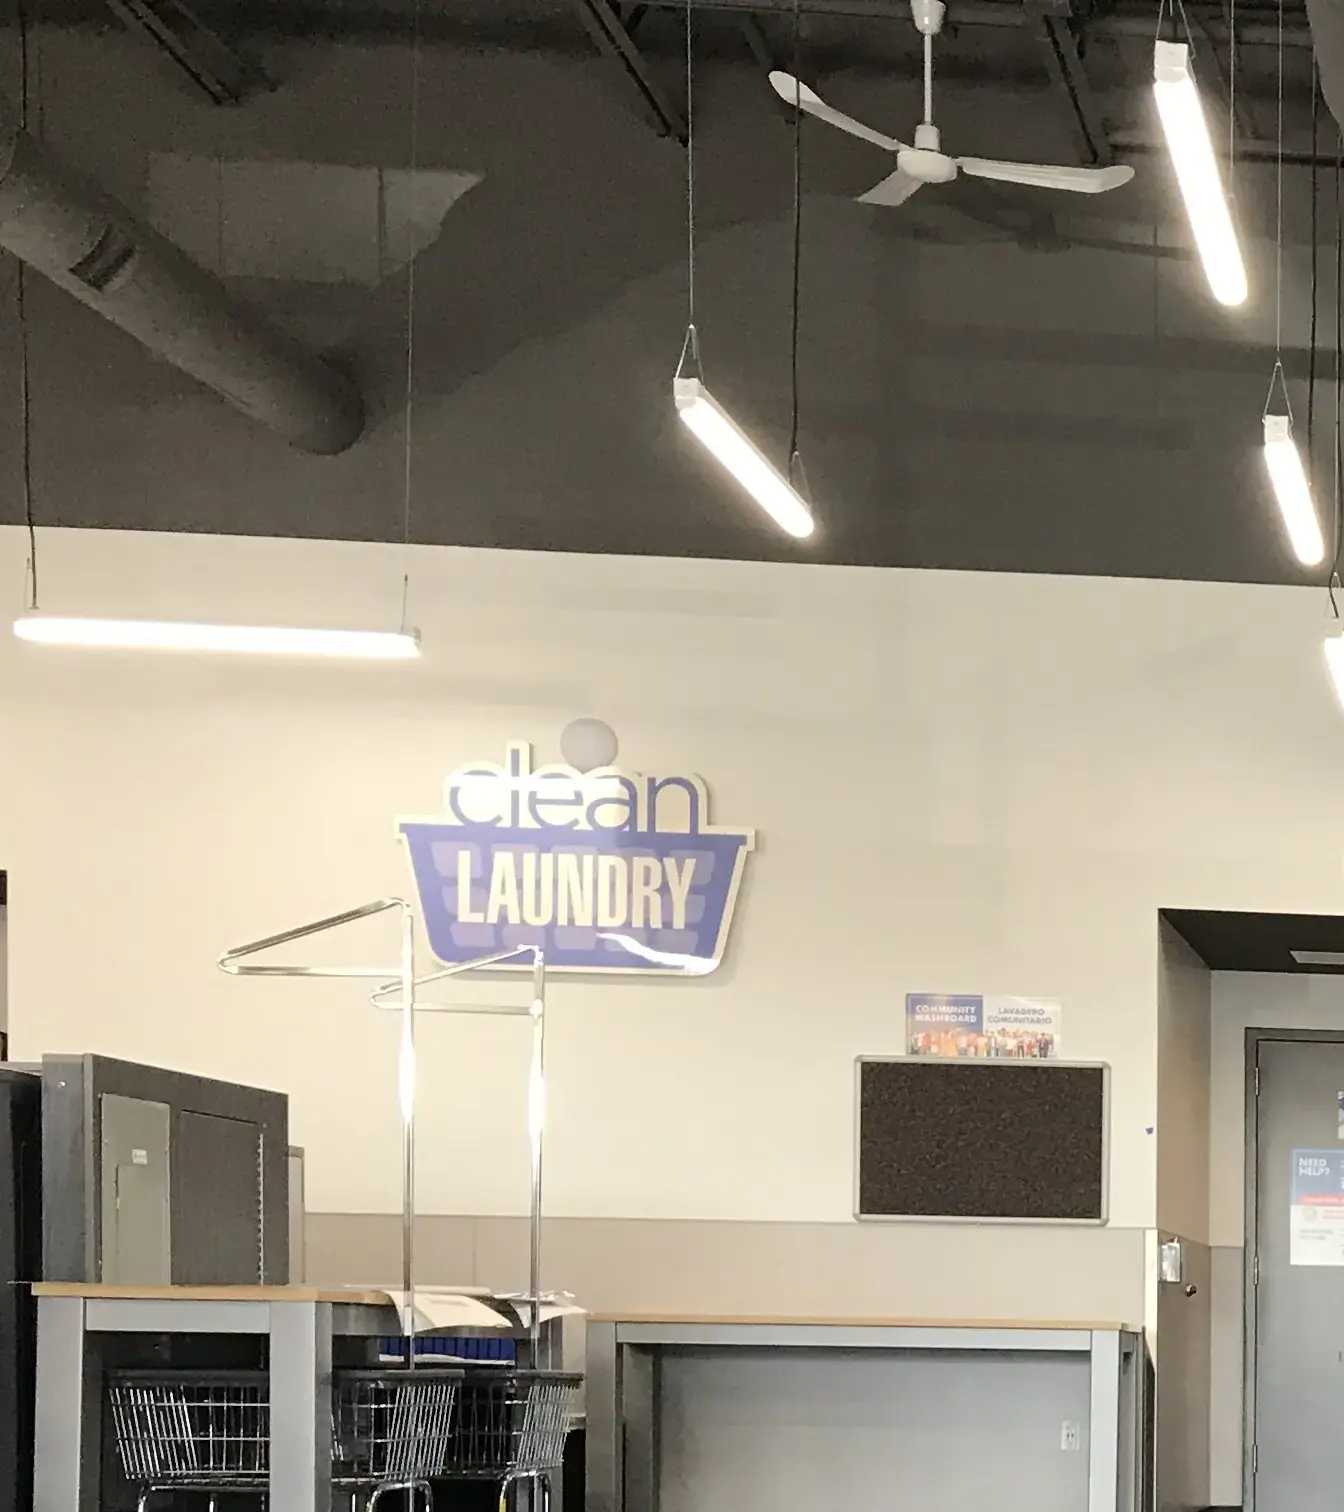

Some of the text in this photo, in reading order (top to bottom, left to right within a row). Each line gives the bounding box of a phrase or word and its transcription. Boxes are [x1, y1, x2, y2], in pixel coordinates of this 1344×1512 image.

[449, 748, 699, 833] clean
[457, 849, 697, 930] LAUNDRY
[915, 1004, 977, 1014] COMMUNITY
[998, 1007, 1045, 1016] LAVADERO
[914, 1013, 977, 1023] WASHBOARD
[987, 1015, 1052, 1024] COMUNITARIO
[1298, 1157, 1327, 1167] NEED
[1298, 1167, 1331, 1177] HELP?
